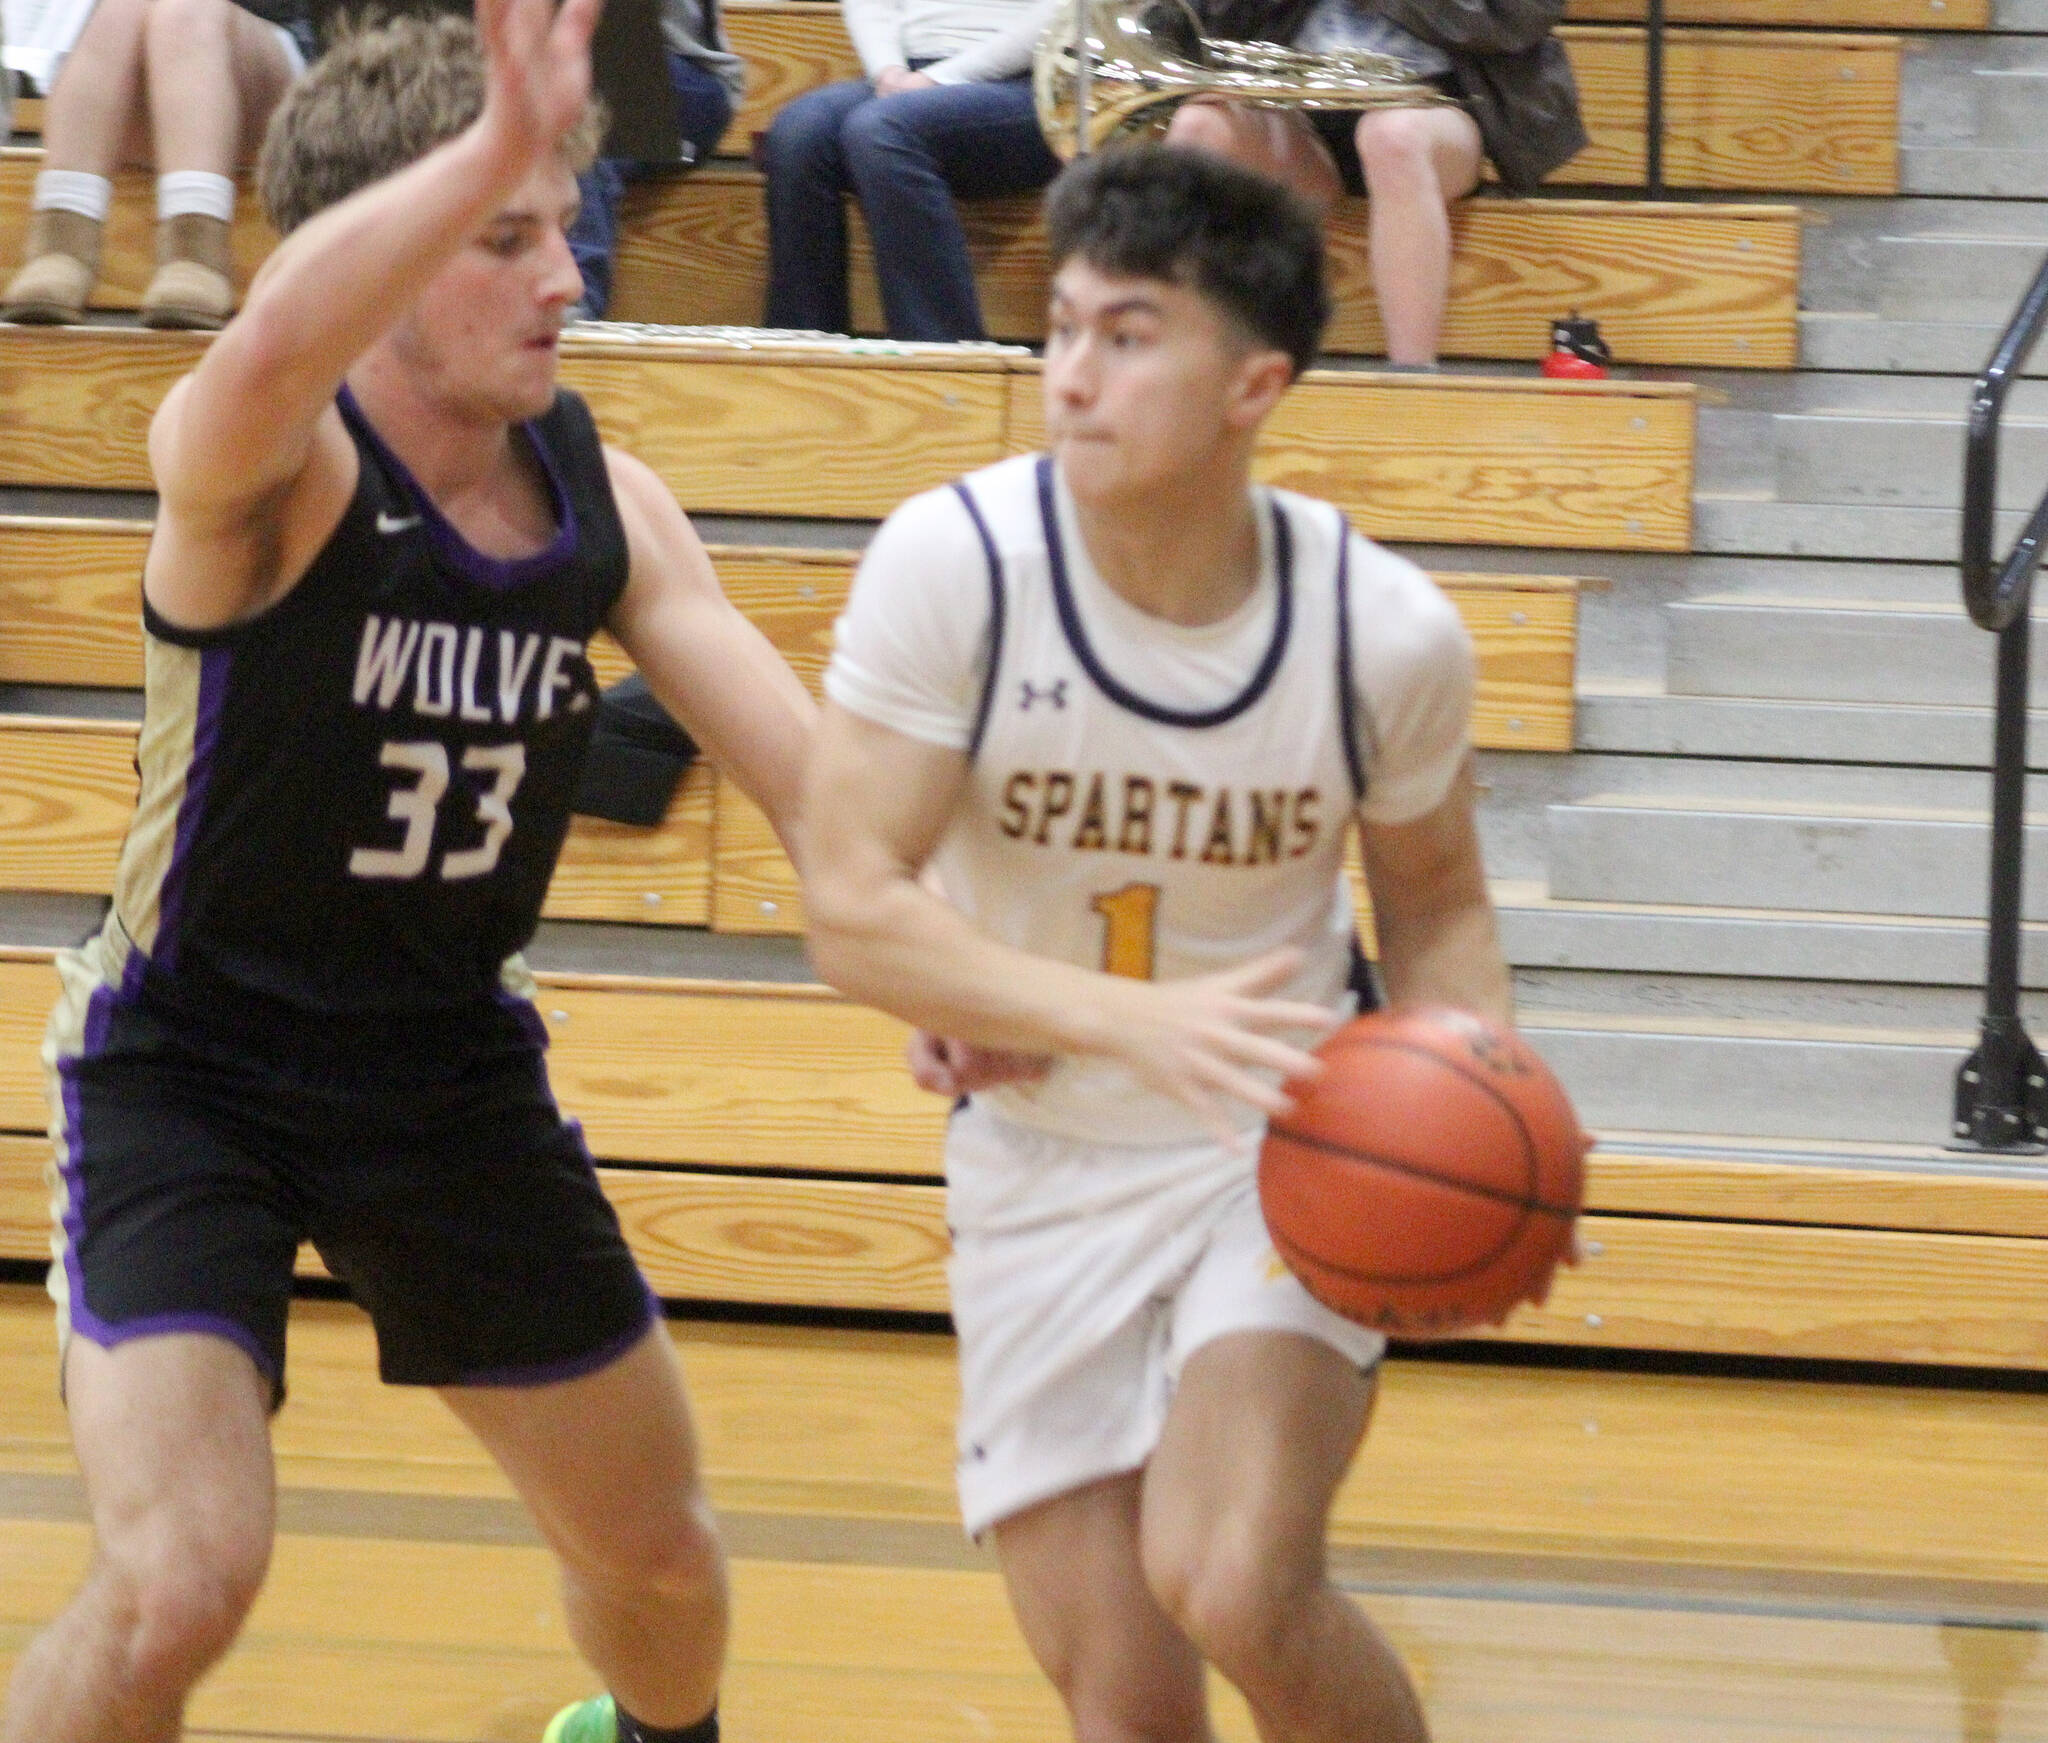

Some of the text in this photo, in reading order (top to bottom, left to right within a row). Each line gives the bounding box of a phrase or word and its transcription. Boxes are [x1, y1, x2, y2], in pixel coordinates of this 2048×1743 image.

[352, 614, 591, 725] WOLVE
[349, 741, 526, 880] 33
[1000, 771, 1320, 867] SPARTANS
[1090, 881, 1163, 982] 1
